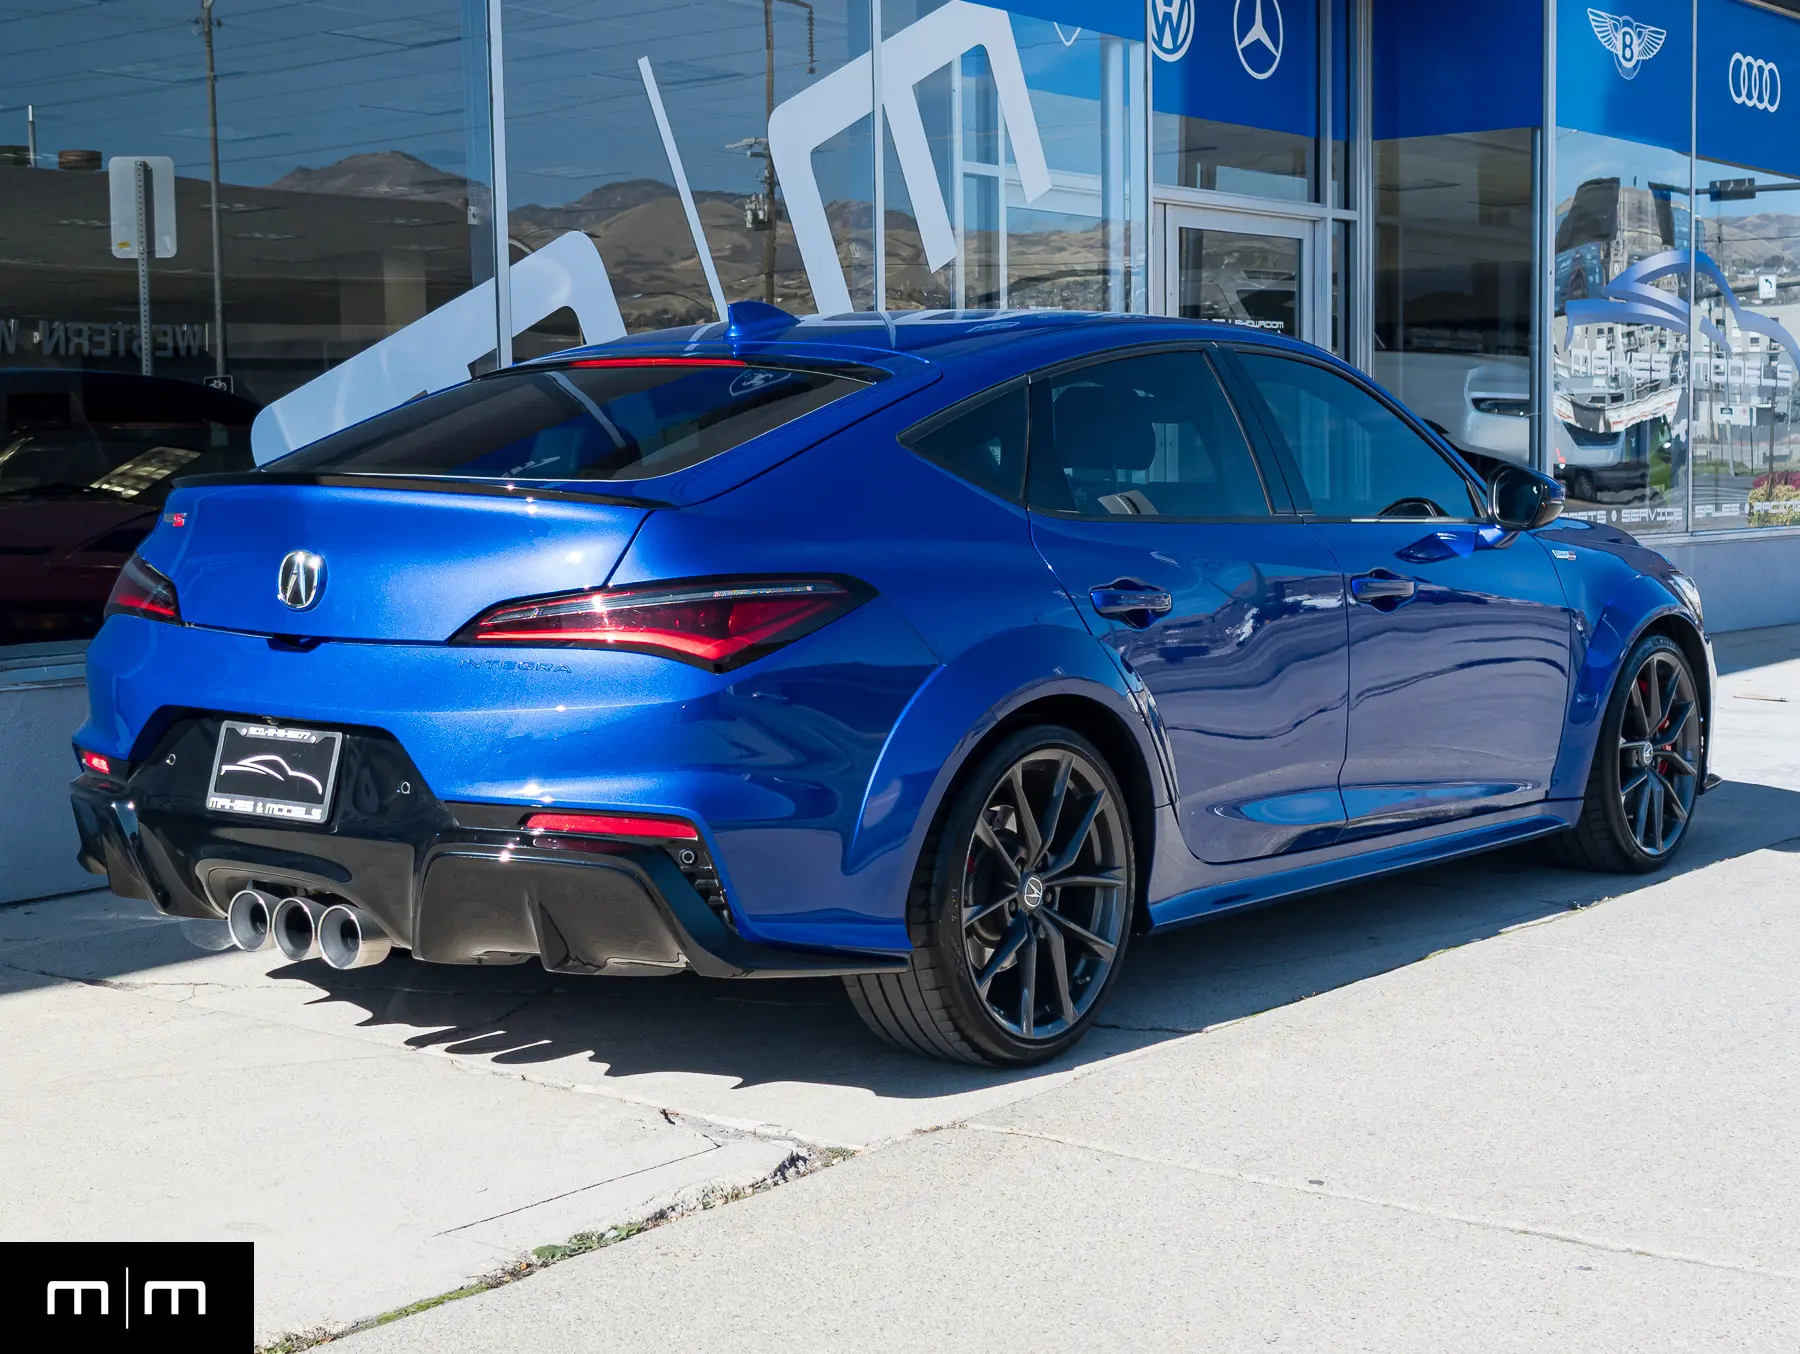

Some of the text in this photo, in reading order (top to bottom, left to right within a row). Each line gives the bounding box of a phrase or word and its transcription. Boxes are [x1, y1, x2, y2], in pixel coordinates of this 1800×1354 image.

[1621, 507, 1683, 523] SERVICE
[1695, 503, 1740, 518] SALES
[459, 659, 572, 674] INTEGRA
[264, 803, 323, 821] MODELS
